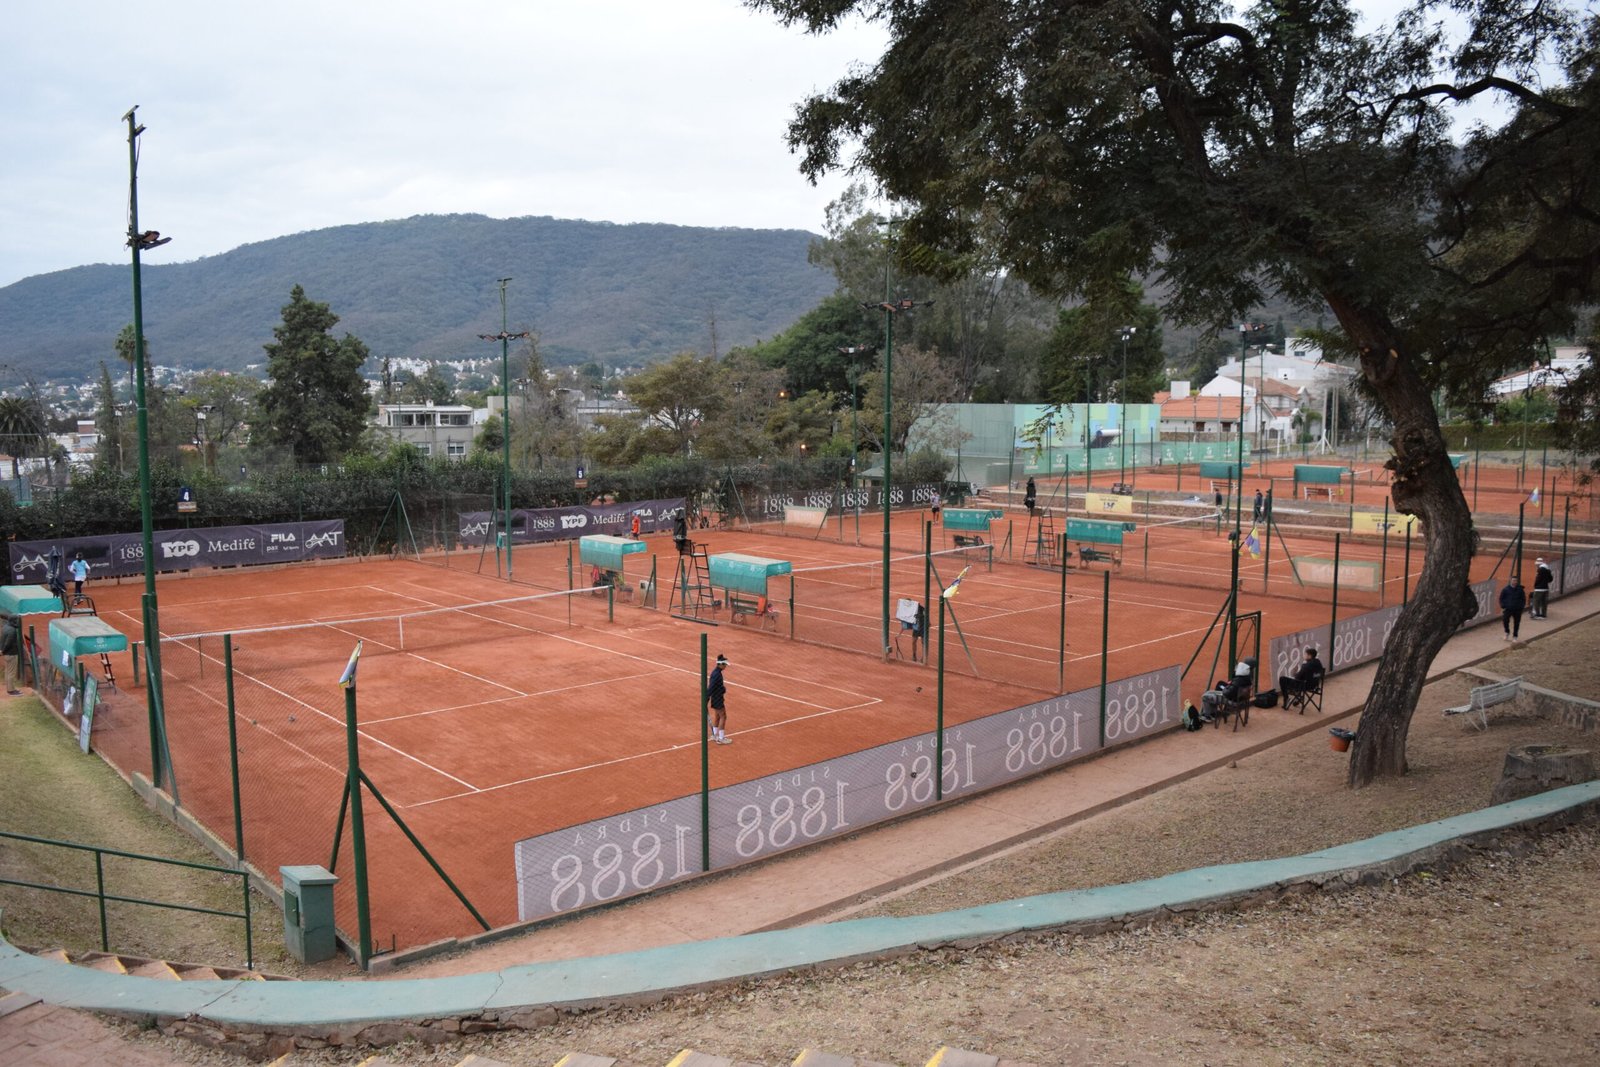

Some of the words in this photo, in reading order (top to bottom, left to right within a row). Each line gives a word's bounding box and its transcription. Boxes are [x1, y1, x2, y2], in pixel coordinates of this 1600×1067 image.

[183, 491, 190, 501] 4
[877, 490, 904, 505] 188
[532, 517, 556, 529] 1888
[592, 513, 625, 525] Medifé
[271, 532, 296, 543] FILA
[207, 538, 256, 553] Medifé
[120, 546, 145, 560] 188
